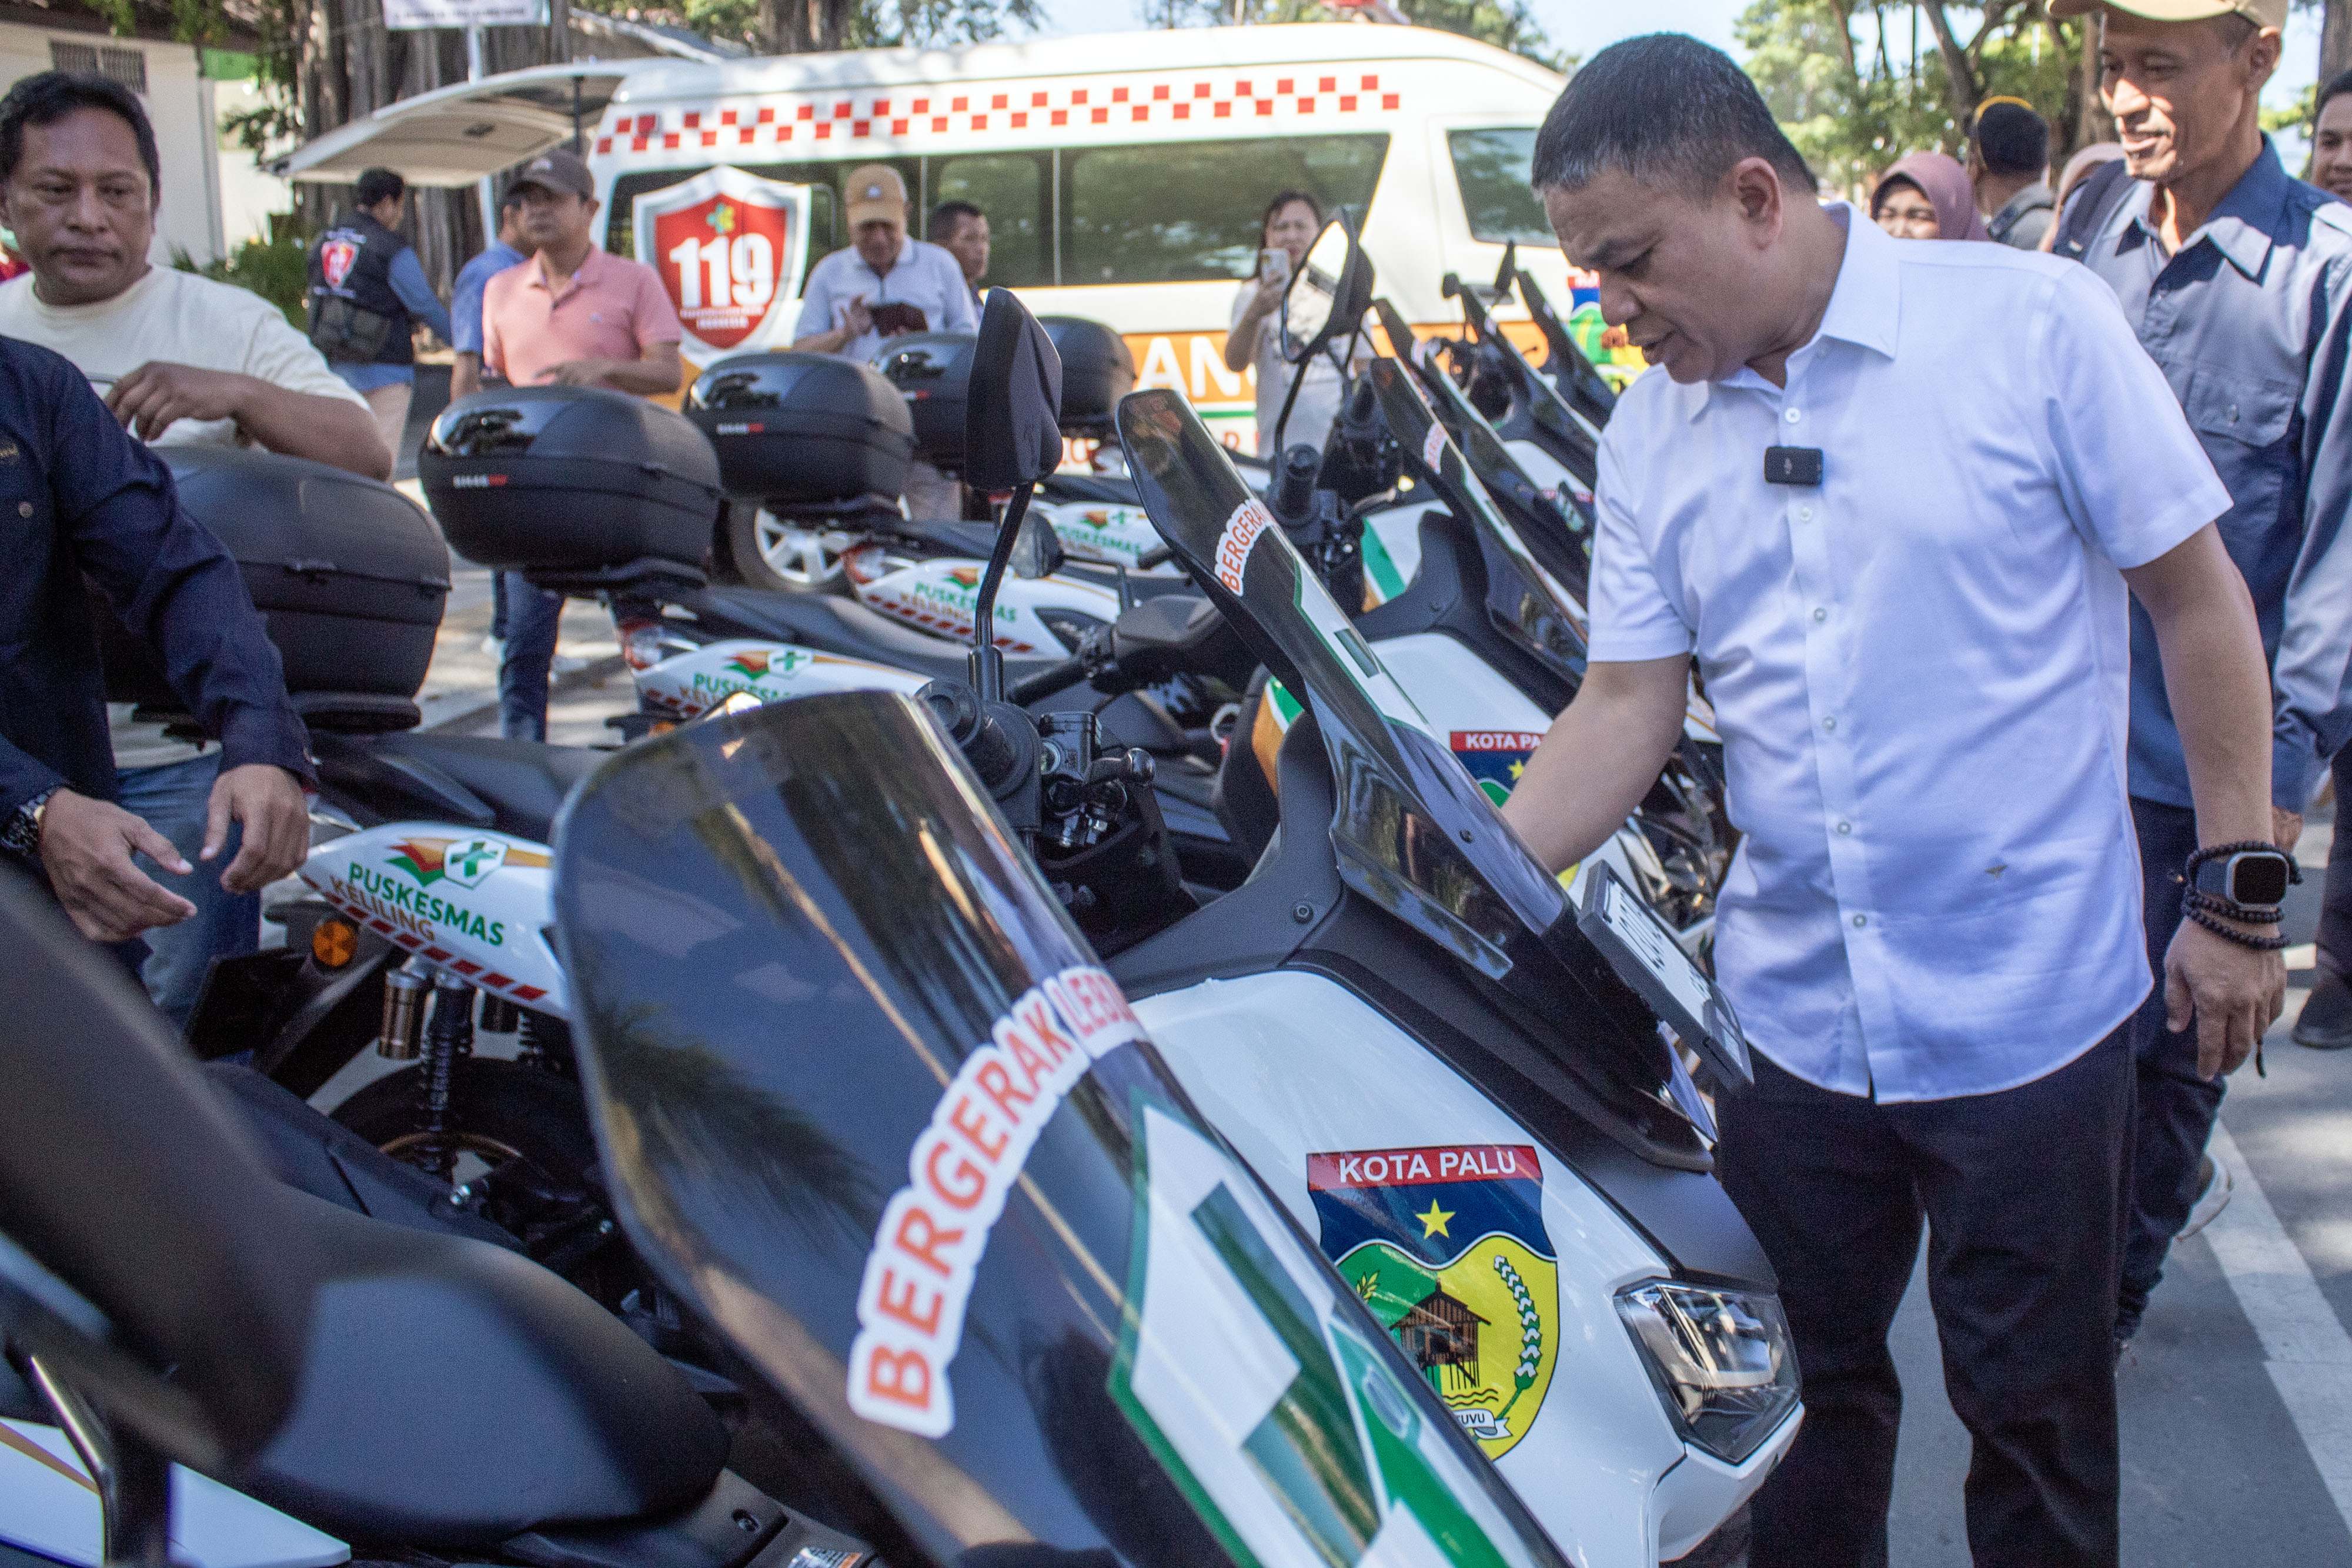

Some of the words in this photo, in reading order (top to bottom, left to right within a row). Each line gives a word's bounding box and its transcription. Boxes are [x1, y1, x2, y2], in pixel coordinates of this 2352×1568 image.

[669, 232, 774, 308] 119
[914, 581, 1017, 623] PUSKESAS
[1466, 733, 1517, 748] KOTA
[1519, 734, 1542, 748] PA
[329, 873, 436, 942] KELILING
[348, 861, 506, 947] PUSKESMAS
[1339, 1153, 1432, 1183] KOTA
[1439, 1150, 1516, 1176] PALU
[867, 997, 1074, 1411] BERGERAK
